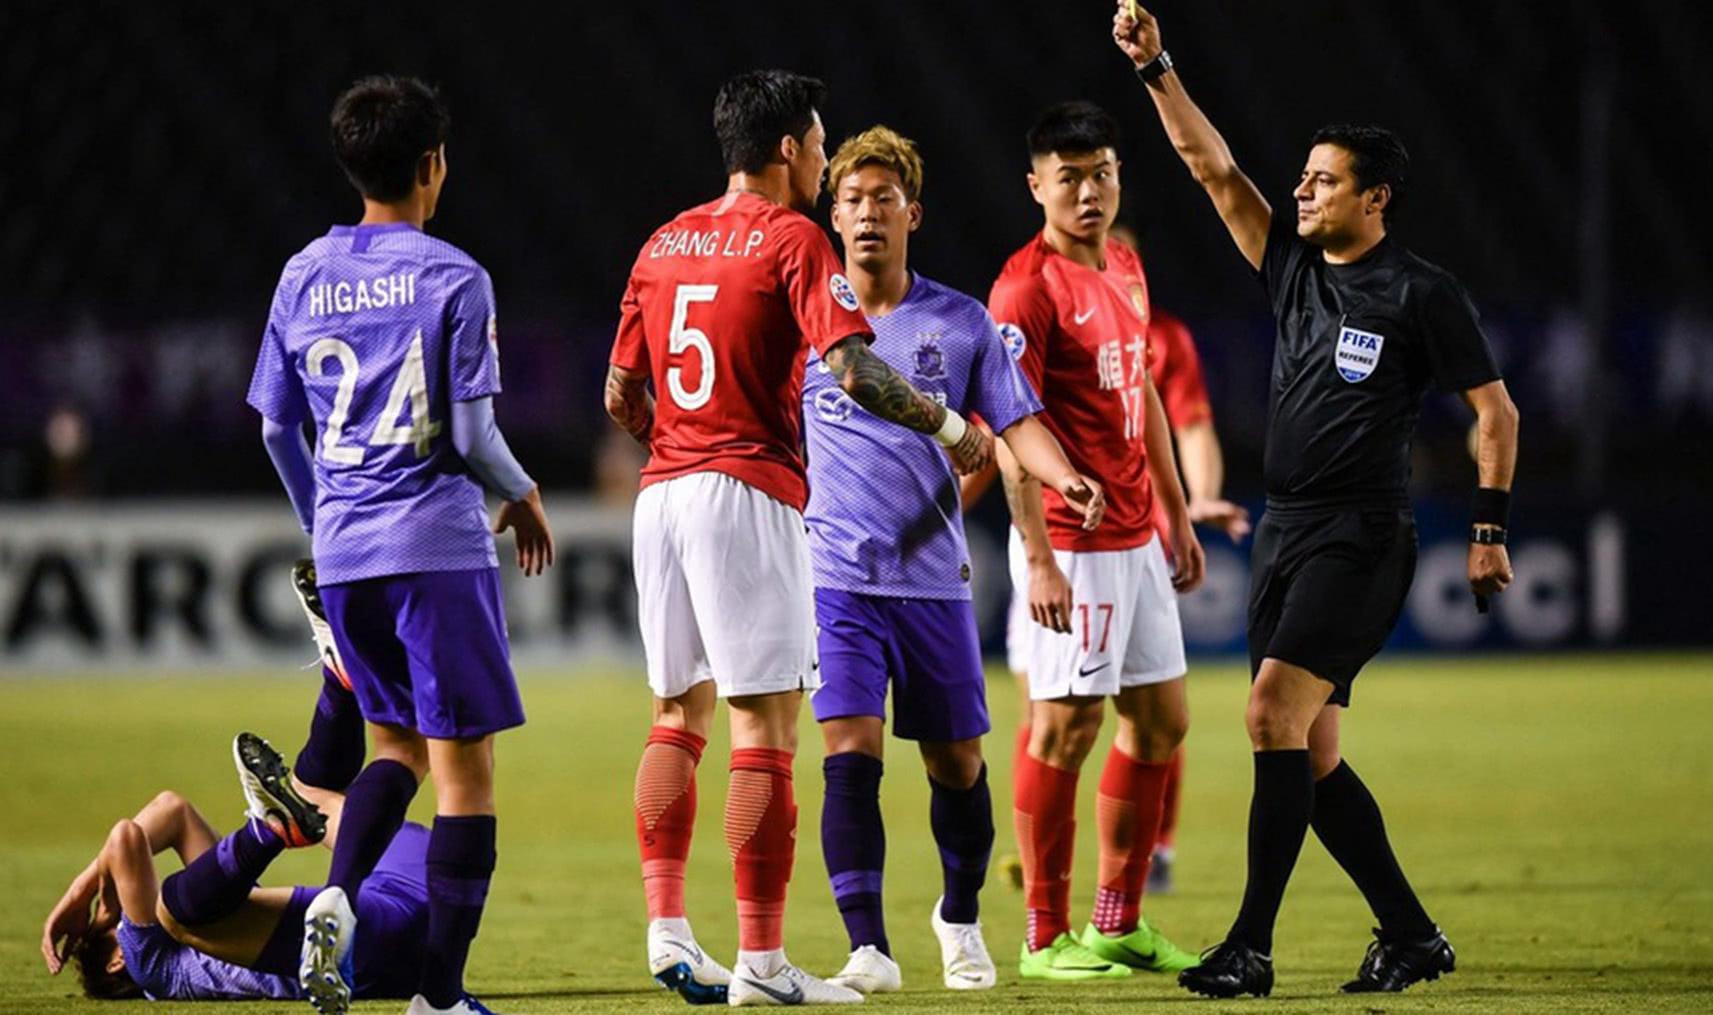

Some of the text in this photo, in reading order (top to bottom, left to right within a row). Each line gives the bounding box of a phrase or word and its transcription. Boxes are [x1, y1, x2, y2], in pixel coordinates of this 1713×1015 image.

[650, 230, 765, 259] ZHANG L.P.
[309, 273, 415, 318] HIGASHI
[667, 284, 719, 411] 5
[1338, 351, 1374, 366] REFEREE
[1342, 330, 1377, 351] FIFA
[305, 328, 442, 466] 24
[1121, 386, 1141, 440] 17
[1078, 603, 1114, 653] 17
